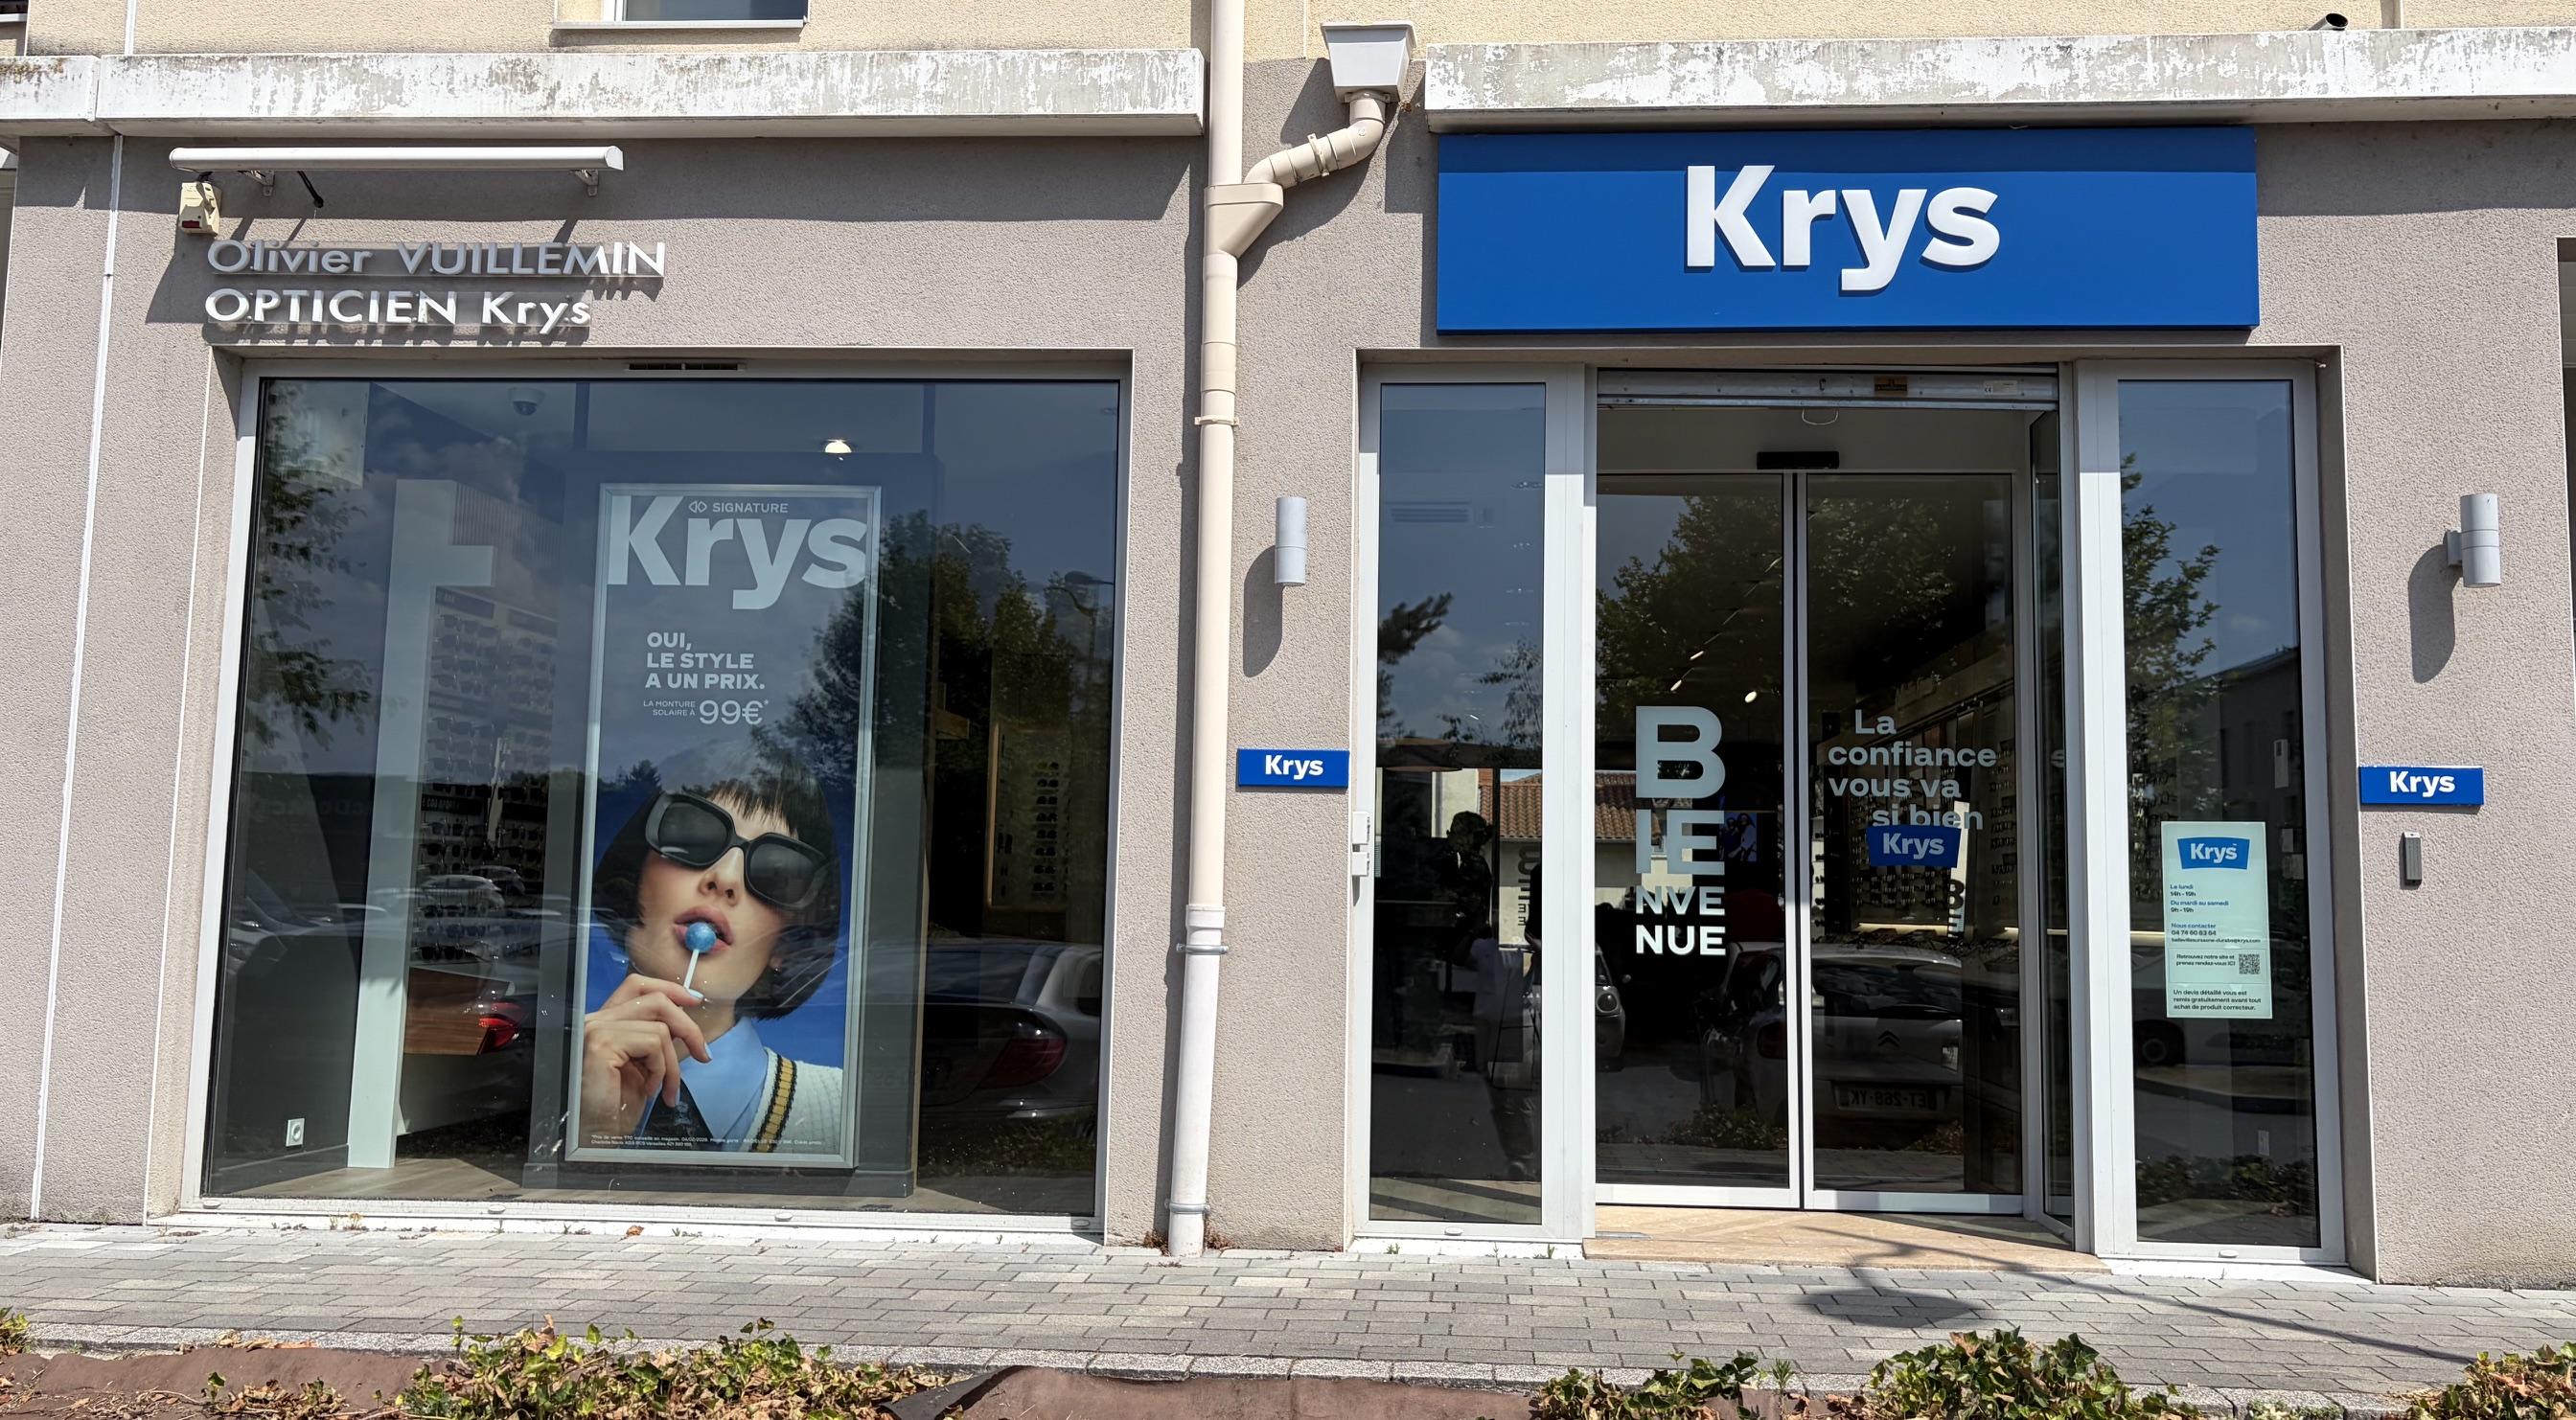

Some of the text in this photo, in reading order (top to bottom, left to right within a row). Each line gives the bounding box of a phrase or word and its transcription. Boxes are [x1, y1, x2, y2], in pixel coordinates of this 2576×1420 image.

[1685, 164, 2001, 292] Krys
[207, 240, 666, 278] Olivier VUILLEMIN
[204, 288, 591, 334] OPTICIEN Krys
[712, 502, 789, 514] SIGNATURE
[607, 495, 867, 609] Krys
[647, 631, 692, 651] OUI,
[647, 653, 754, 669] LE STYLE
[645, 673, 766, 690] A UN PRIX.
[653, 708, 688, 717] SOLAIRE
[1855, 709, 1897, 734] La
[1636, 706, 1725, 798] B
[1828, 741, 1998, 767] confiance
[1265, 755, 1323, 780] Krys
[1828, 777, 1962, 798] vous va
[2390, 771, 2455, 797] Krys
[1872, 803, 1984, 830] si bien
[1636, 810, 1725, 875] IE
[1883, 833, 1945, 859] Krys
[2190, 843, 2238, 864] Krys
[1635, 885, 1725, 915] NVE
[1636, 925, 1726, 955] NUE
